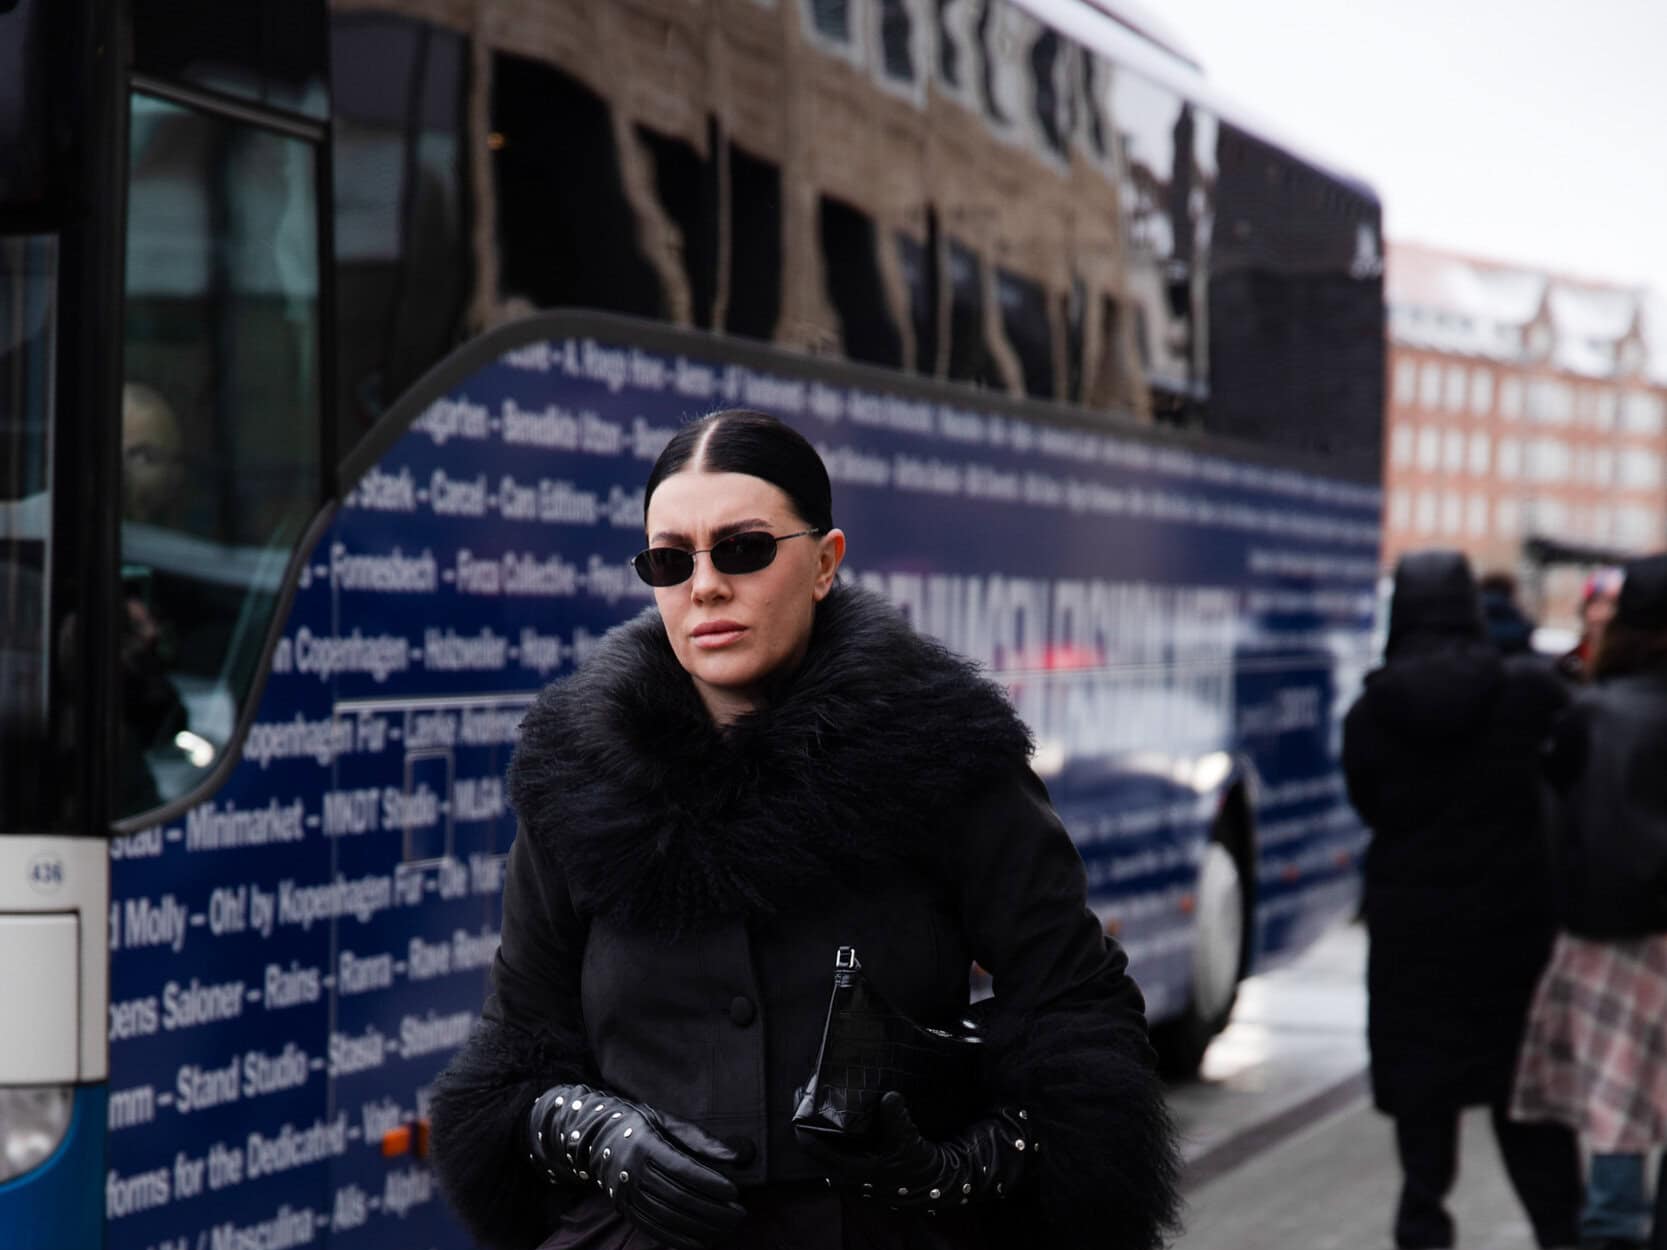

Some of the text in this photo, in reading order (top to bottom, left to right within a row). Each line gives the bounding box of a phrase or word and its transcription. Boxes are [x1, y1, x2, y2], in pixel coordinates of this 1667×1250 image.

[501, 550, 578, 596] Collective
[296, 625, 408, 684] Copenhagen
[186, 799, 304, 852] Minimarket
[381, 781, 439, 831] Studio
[124, 893, 188, 954] Molly
[209, 884, 247, 937] Oh!
[250, 883, 275, 938] by
[278, 872, 392, 931] Kopenhagen
[163, 977, 244, 1030] Saloner
[264, 960, 319, 1010] Rains
[176, 1054, 239, 1113] Stand
[244, 1042, 308, 1098] Studio
[105, 1168, 170, 1219] forms
[174, 1151, 205, 1198] for
[208, 1141, 244, 1190] the
[247, 1112, 347, 1179] Dedicated
